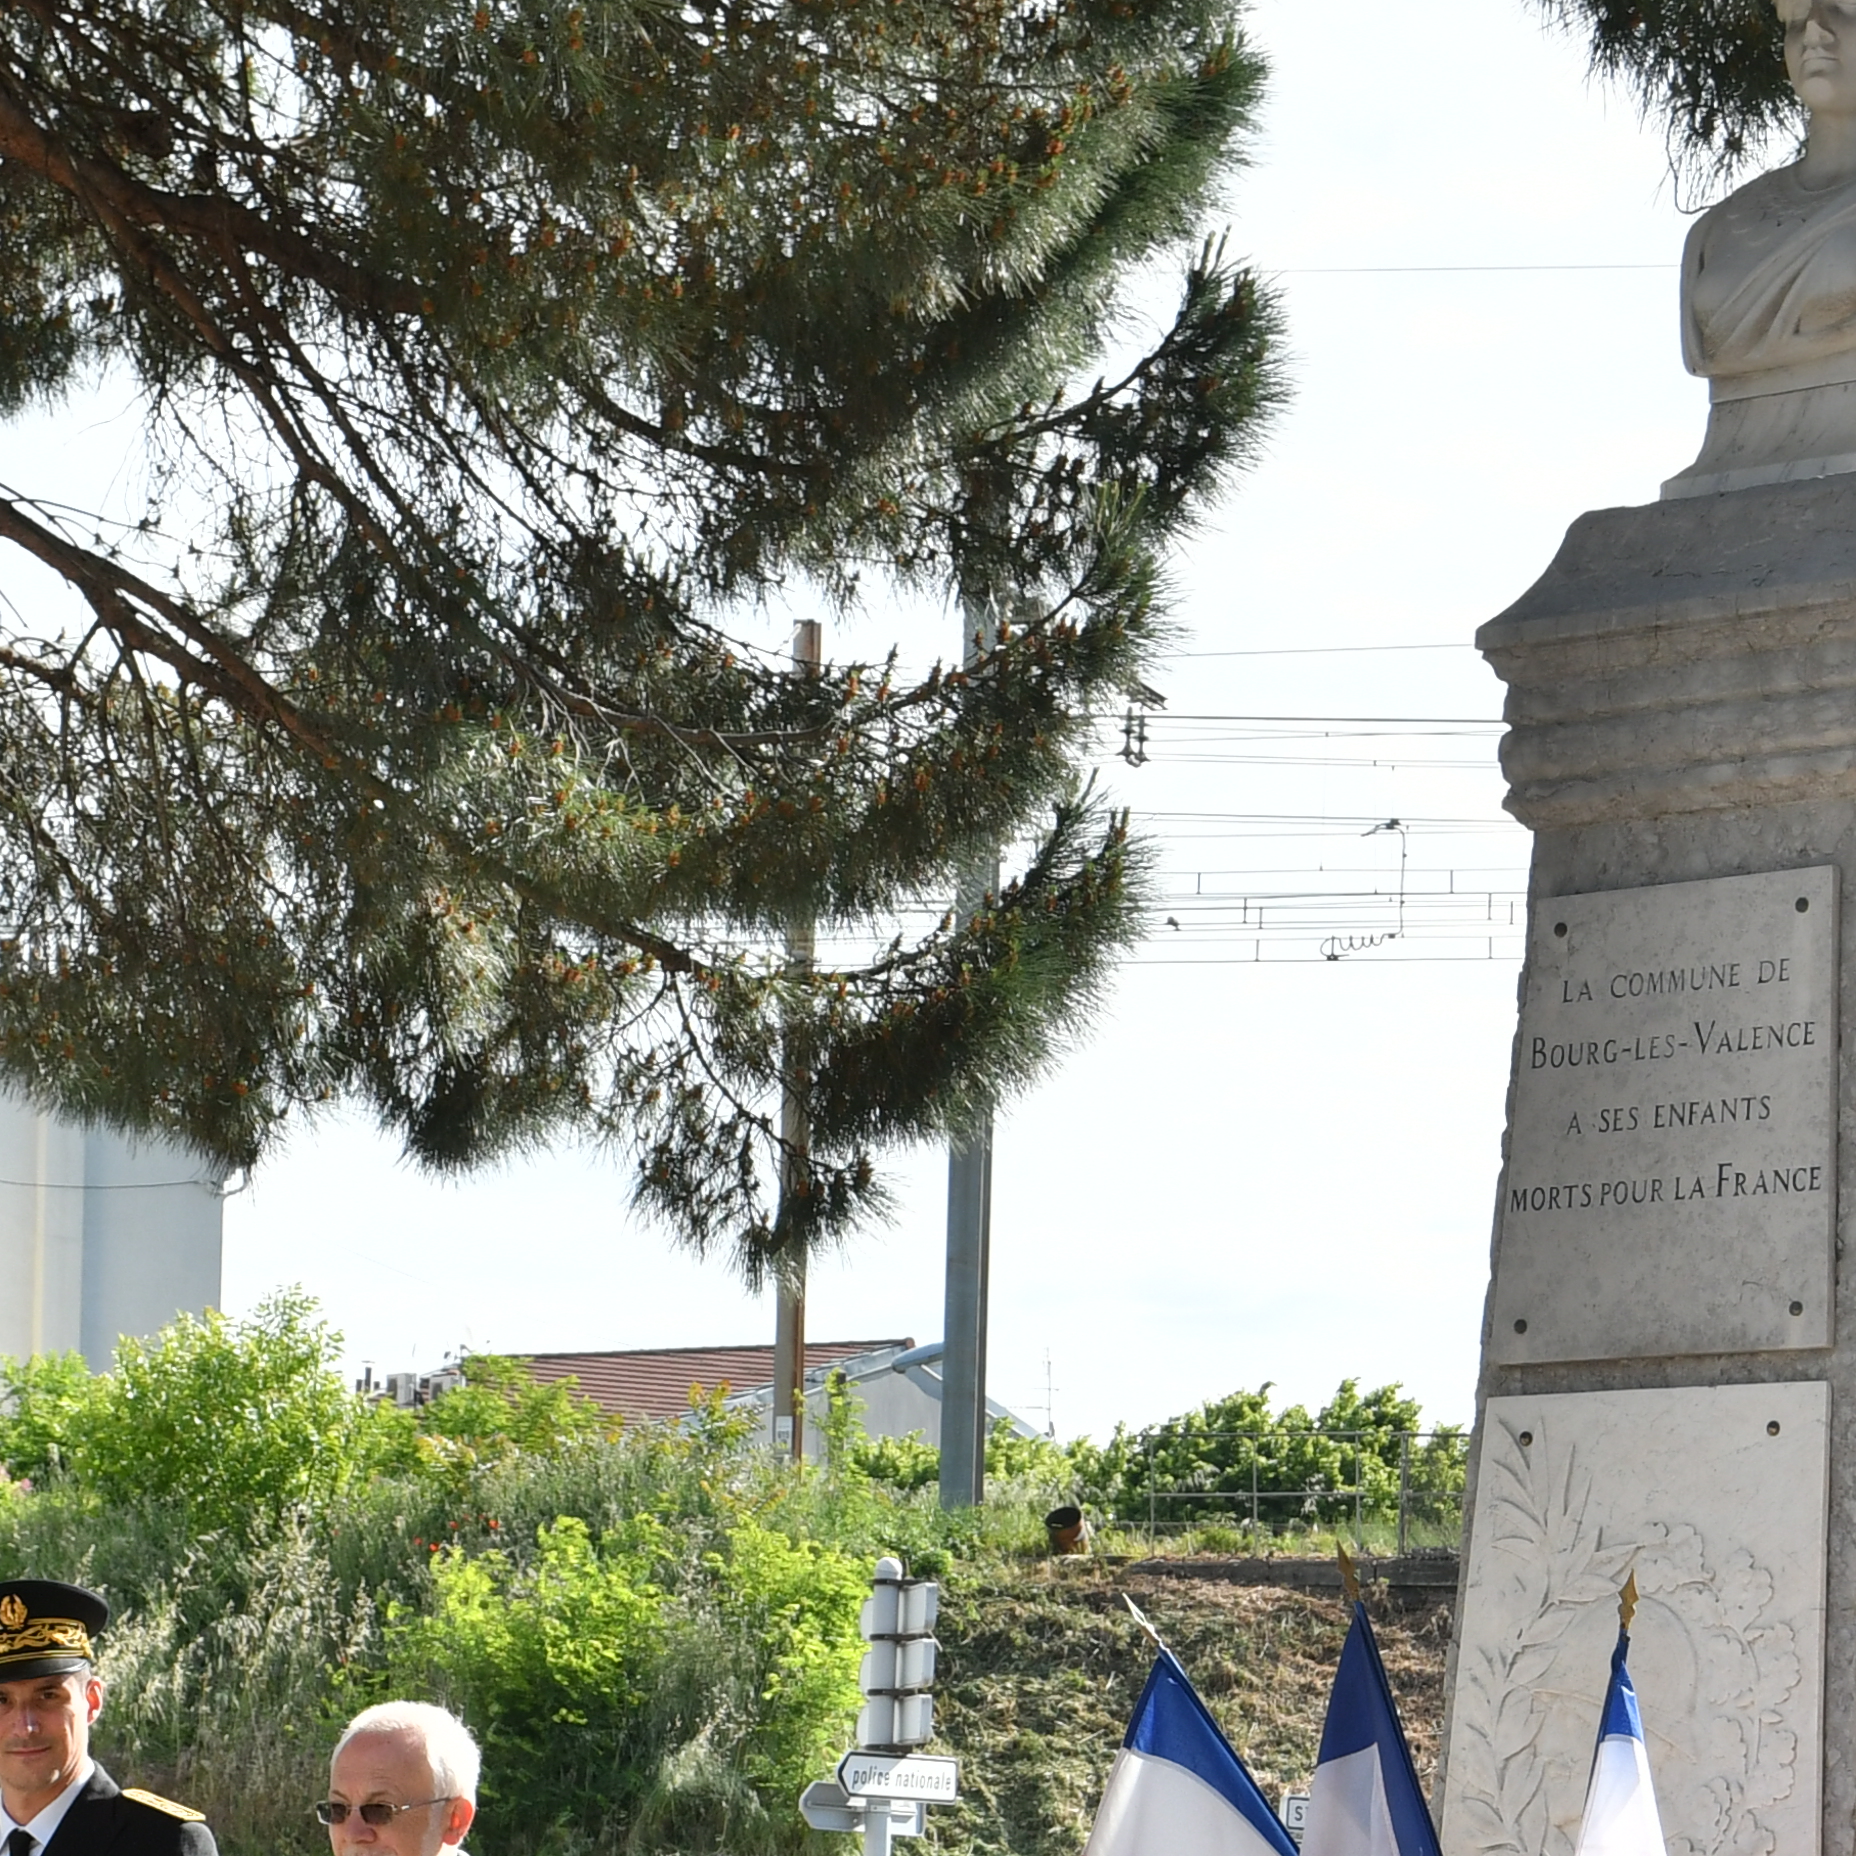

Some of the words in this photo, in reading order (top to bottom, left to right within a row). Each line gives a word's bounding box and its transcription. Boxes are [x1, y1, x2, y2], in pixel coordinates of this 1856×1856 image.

[1562, 979, 1593, 1003] LA
[1610, 963, 1740, 999] COMMUNE
[1757, 958, 1790, 985] DE
[1531, 1020, 1816, 1069] BOURG-LES-VALENCE
[1567, 1112, 1582, 1135] A
[1599, 1107, 1639, 1133] SES
[1654, 1096, 1771, 1129] ENFANTS
[1510, 1184, 1592, 1213] MORTS
[1600, 1179, 1663, 1206] POUR
[1674, 1176, 1705, 1200] LA
[1717, 1163, 1821, 1198] FRANCE
[852, 1766, 890, 1789] police
[895, 1770, 951, 1790] nationale
